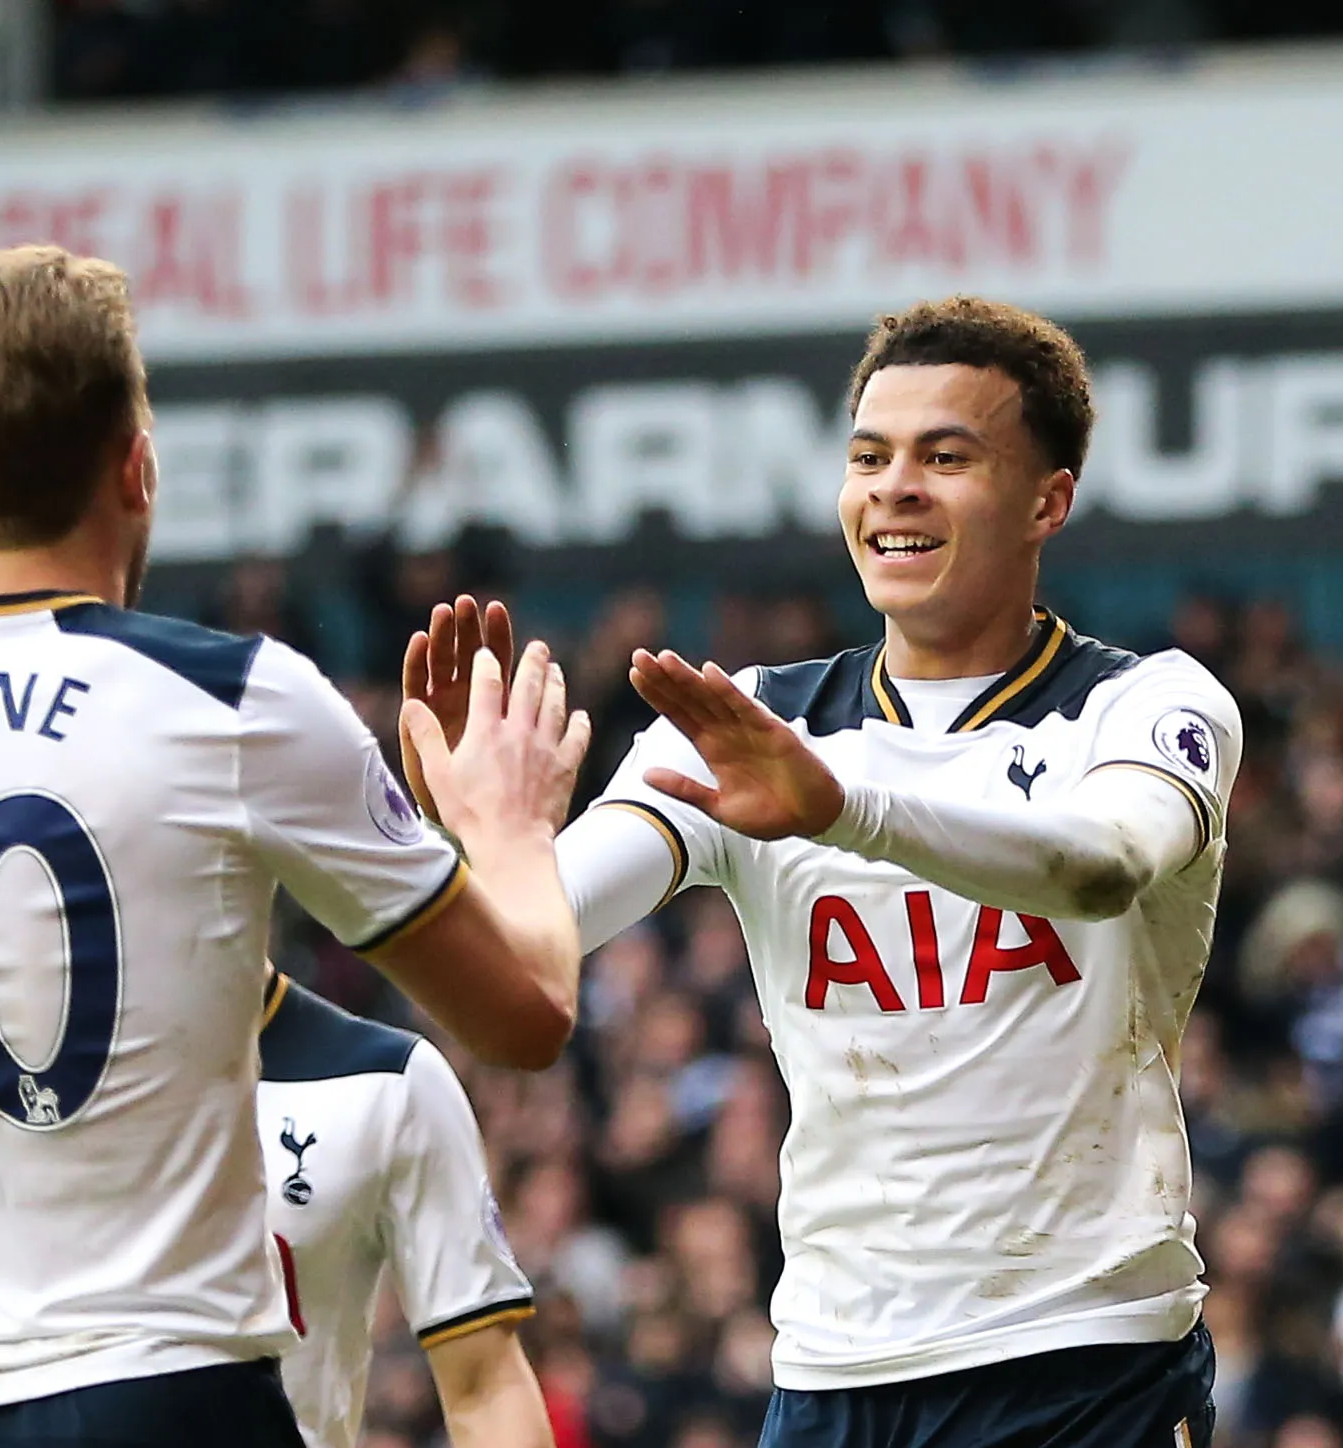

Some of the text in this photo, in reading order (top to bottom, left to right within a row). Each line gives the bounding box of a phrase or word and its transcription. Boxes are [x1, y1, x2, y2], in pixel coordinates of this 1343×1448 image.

[281, 166, 519, 314] LIFE
[539, 130, 1139, 308] COMPANY
[804, 890, 1082, 1013] AIA
